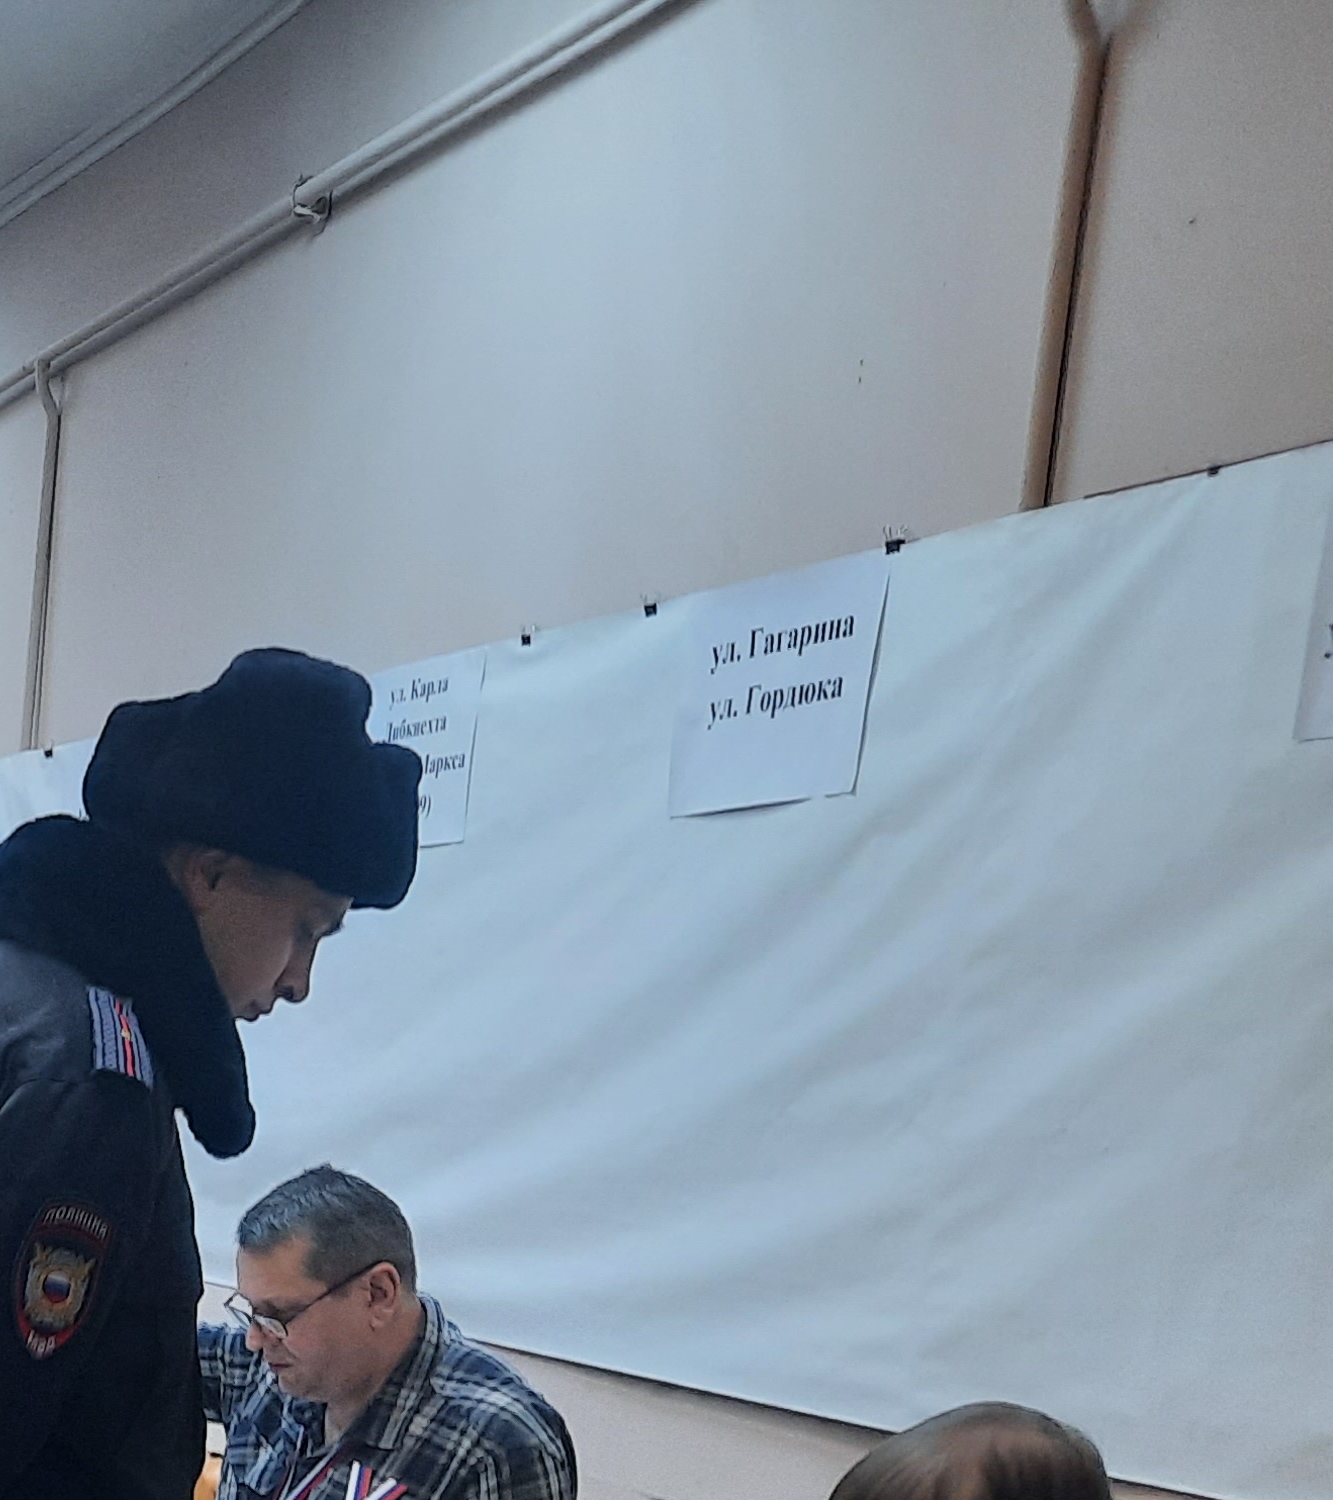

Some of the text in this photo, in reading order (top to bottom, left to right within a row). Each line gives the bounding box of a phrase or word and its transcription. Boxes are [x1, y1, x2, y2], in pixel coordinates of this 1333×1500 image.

[710, 614, 855, 675] ул. Гагарина
[389, 677, 449, 711] ул. Карла
[707, 676, 843, 730] ул. Гордюка
